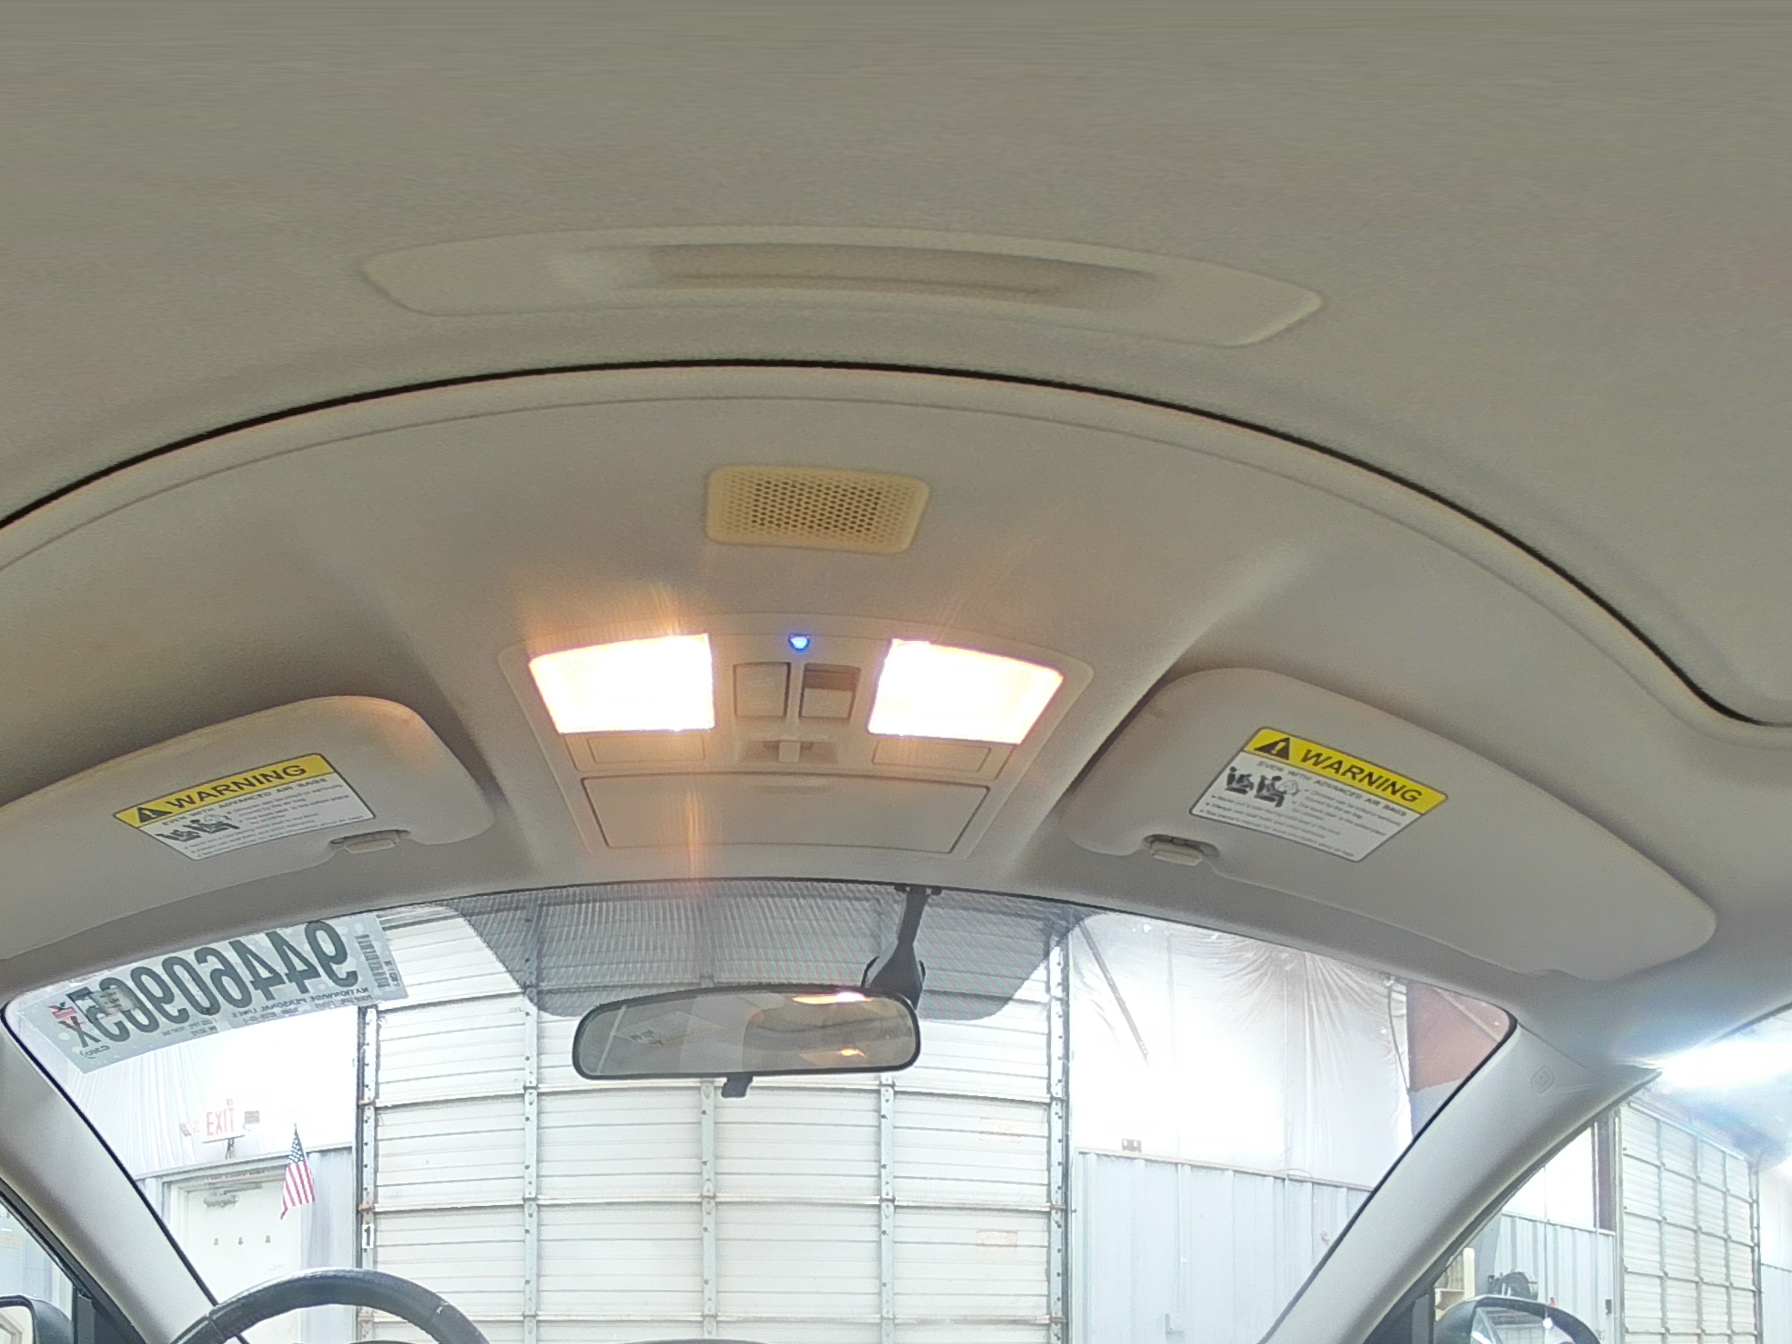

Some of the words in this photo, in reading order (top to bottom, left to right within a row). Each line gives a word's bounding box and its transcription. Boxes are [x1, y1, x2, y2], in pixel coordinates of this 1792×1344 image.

[165, 764, 308, 809] WARNING
[1300, 748, 1423, 803] WARNING
[218, 791, 273, 809] ADVANCED
[206, 1107, 235, 1136] EXIT
[364, 1225, 371, 1247] 1
